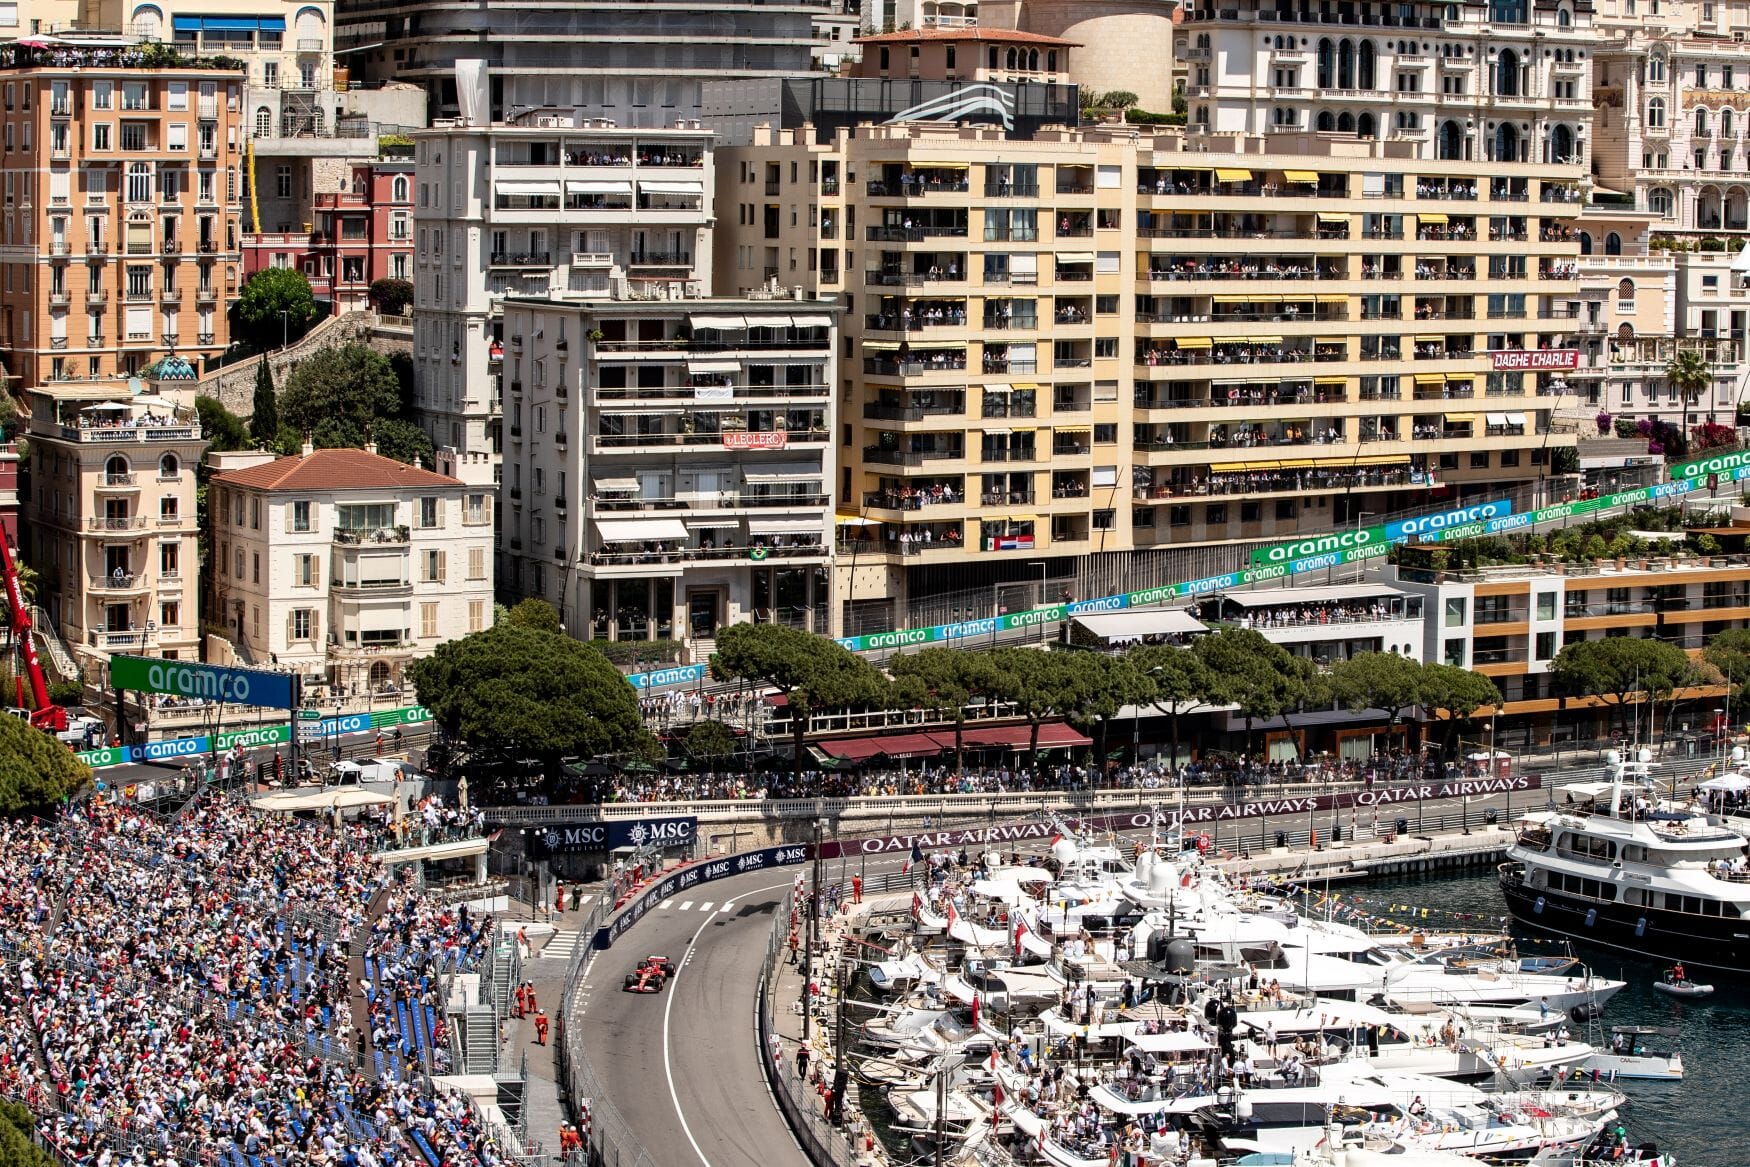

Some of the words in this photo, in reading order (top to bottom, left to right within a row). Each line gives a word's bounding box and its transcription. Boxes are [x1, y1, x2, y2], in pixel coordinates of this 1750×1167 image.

[1494, 353, 1529, 367] DAGHE
[1531, 352, 1574, 366] CHARLIE
[733, 432, 779, 445] LECLERC
[1684, 453, 1750, 476] aramc
[1612, 490, 1646, 505] aramco
[1401, 504, 1497, 534] aramco
[1491, 514, 1527, 530] aramco
[1536, 507, 1572, 521] aramco
[1444, 524, 1481, 540] aramco
[1268, 530, 1371, 560] aramco
[1346, 543, 1386, 561] aramco
[1296, 554, 1336, 572] aramco
[1243, 564, 1285, 582] aramco
[1188, 575, 1232, 593] aramco
[1073, 597, 1121, 612] aramco
[1131, 587, 1176, 604] aramco
[1011, 608, 1060, 626] aramco
[942, 620, 995, 637] aramco
[869, 630, 926, 647] aramco
[148, 665, 250, 700] aramco
[639, 668, 696, 687] aramco
[216, 729, 280, 749] aramco
[131, 740, 197, 759] aramco
[1358, 785, 1433, 805] QATAR
[1438, 776, 1529, 797] AIRWAYS
[1131, 807, 1212, 827] QATAR
[1218, 797, 1318, 819] AIRWAYS
[564, 827, 605, 844] MSC
[650, 821, 690, 840] MSC
[862, 831, 951, 853] QATAR
[745, 853, 764, 866] MSC
[786, 847, 806, 859] MSC
[685, 869, 698, 881] MSC
[711, 861, 730, 875] MSC
